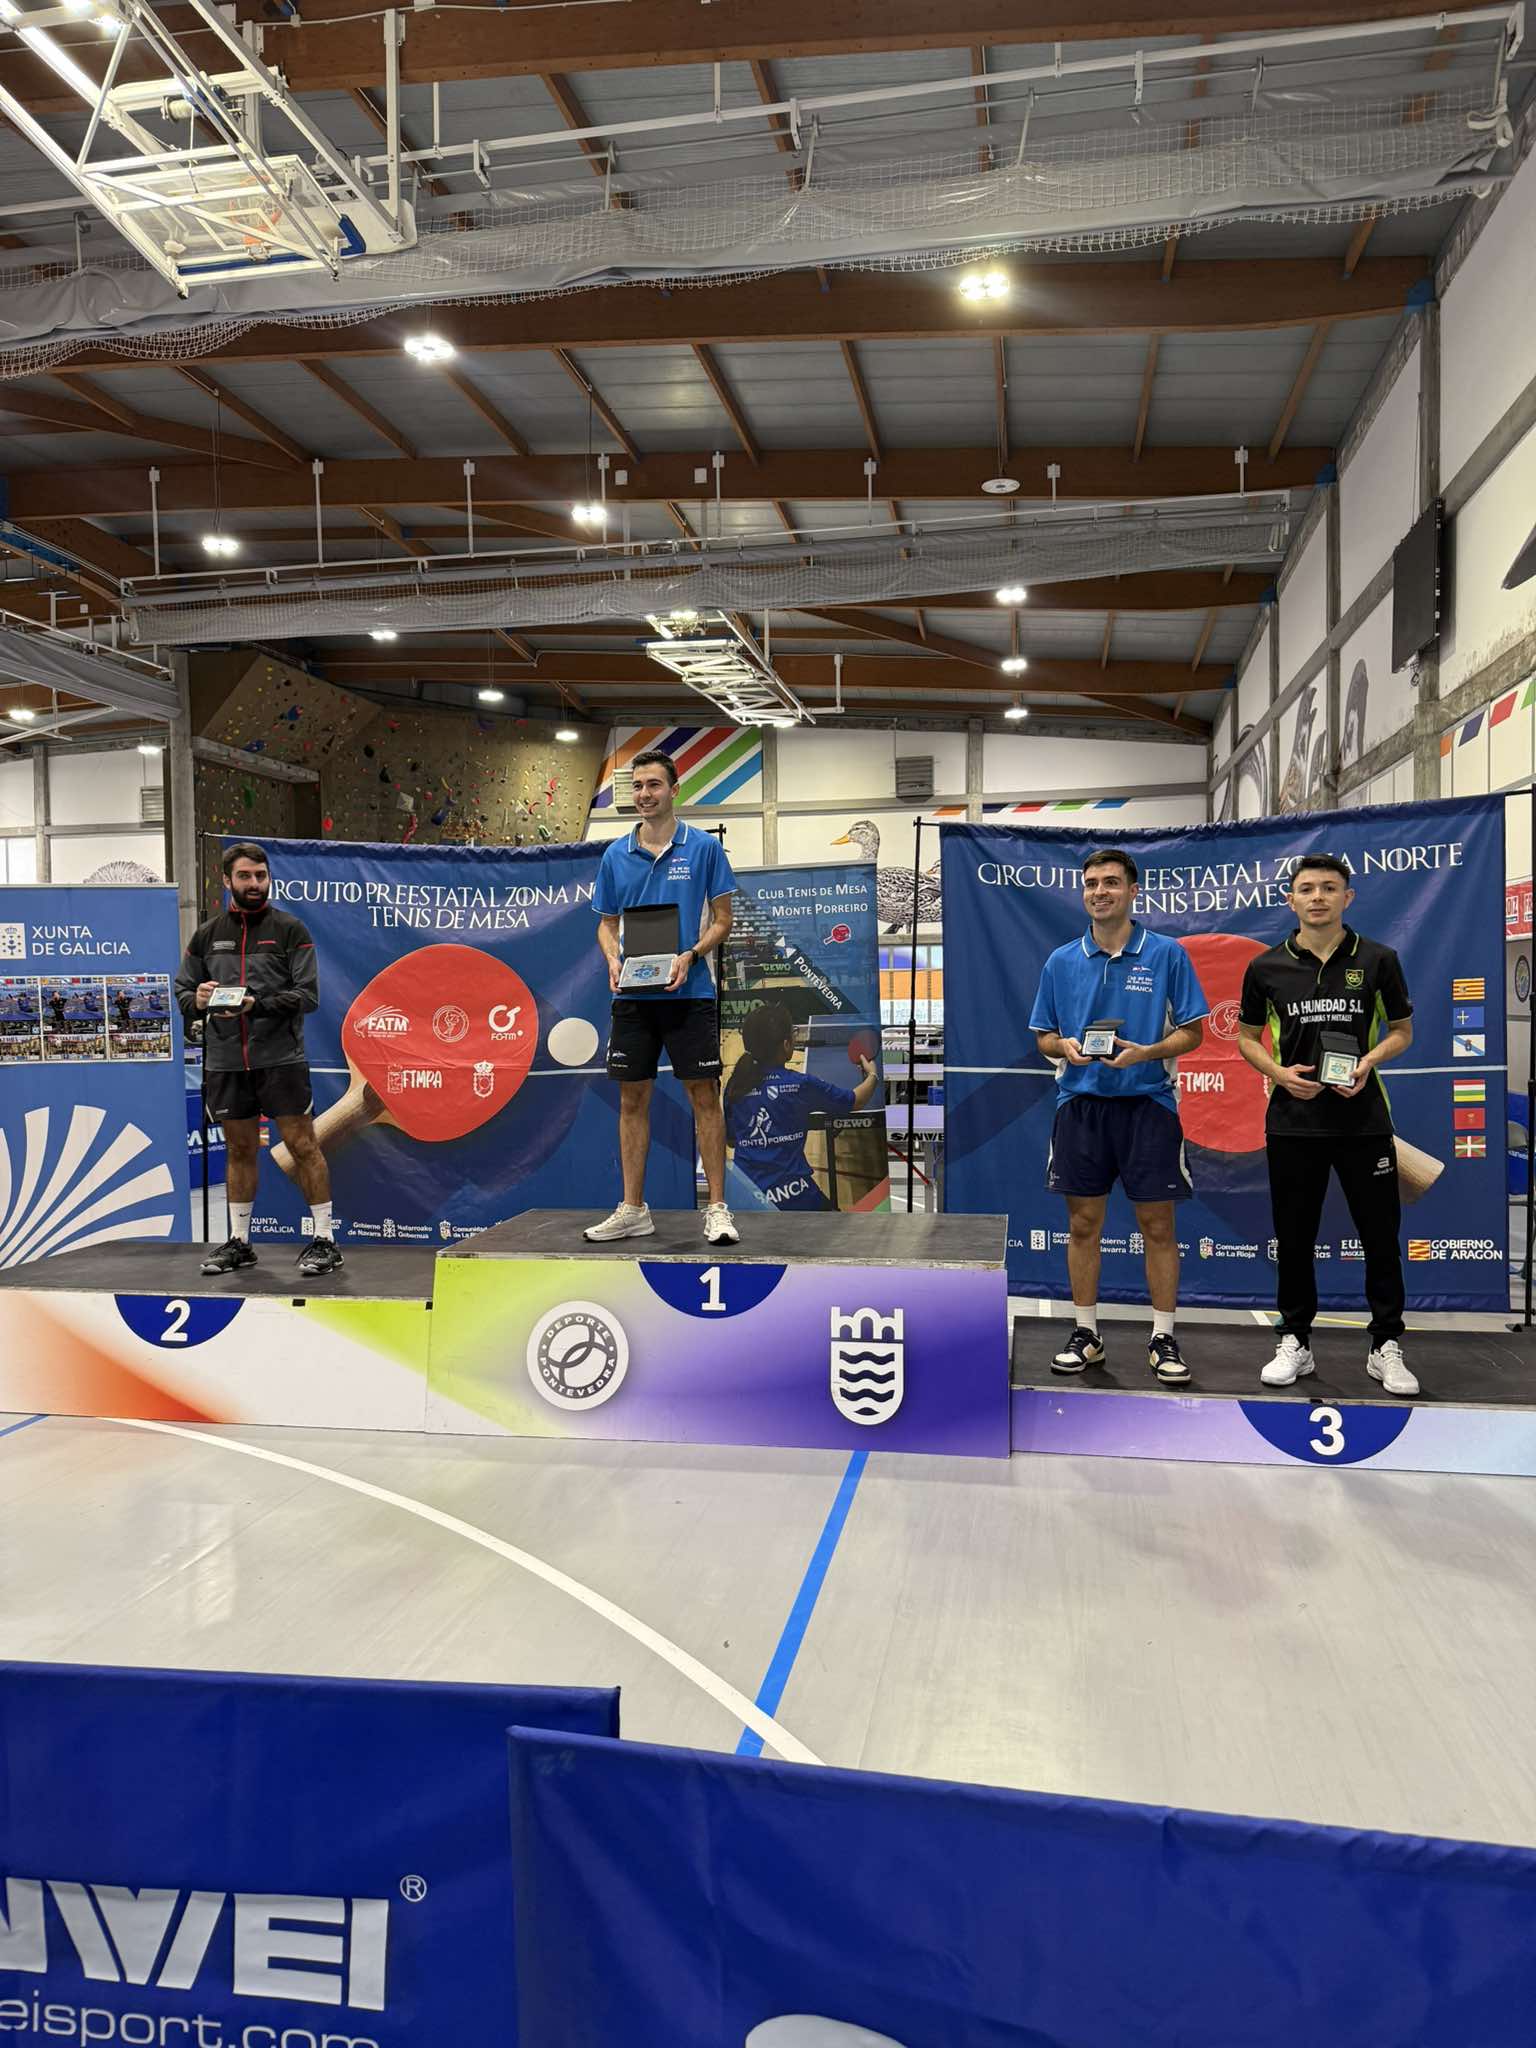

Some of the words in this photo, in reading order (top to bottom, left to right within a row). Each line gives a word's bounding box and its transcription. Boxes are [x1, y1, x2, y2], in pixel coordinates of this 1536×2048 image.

[1139, 861, 1268, 892] EESTATAL
[1364, 843, 1463, 874] NORTE
[267, 879, 362, 903] IRCUITO
[367, 882, 501, 908] PREESTATAL
[504, 885, 568, 908] ZONA
[1132, 890, 1187, 914] ENIS
[1194, 888, 1228, 912] DE
[1234, 882, 1291, 909] MES
[368, 905, 430, 928] TENIS
[435, 908, 464, 929] DE
[469, 908, 530, 929] MESA
[32, 926, 92, 939] XUNTA
[32, 942, 55, 956] DE
[59, 941, 131, 956] GALICIA
[720, 999, 763, 1014] EWO
[1287, 1002, 1300, 1016] LA
[368, 1017, 408, 1031] FATM
[402, 1070, 442, 1089] FTMPA
[1100, 1238, 1126, 1246] bierno
[1215, 1243, 1258, 1251] Comunidad
[1431, 1240, 1494, 1249] GOBIERNO
[1431, 1250, 1447, 1260] DE
[699, 1266, 727, 1311] 1
[160, 1299, 191, 1342] 2
[546, 1315, 611, 1338] DEPORTE
[540, 1357, 615, 1396] PONTEVEDRA
[1309, 1406, 1346, 1457] 3
[0, 1876, 390, 2012] NWEI
